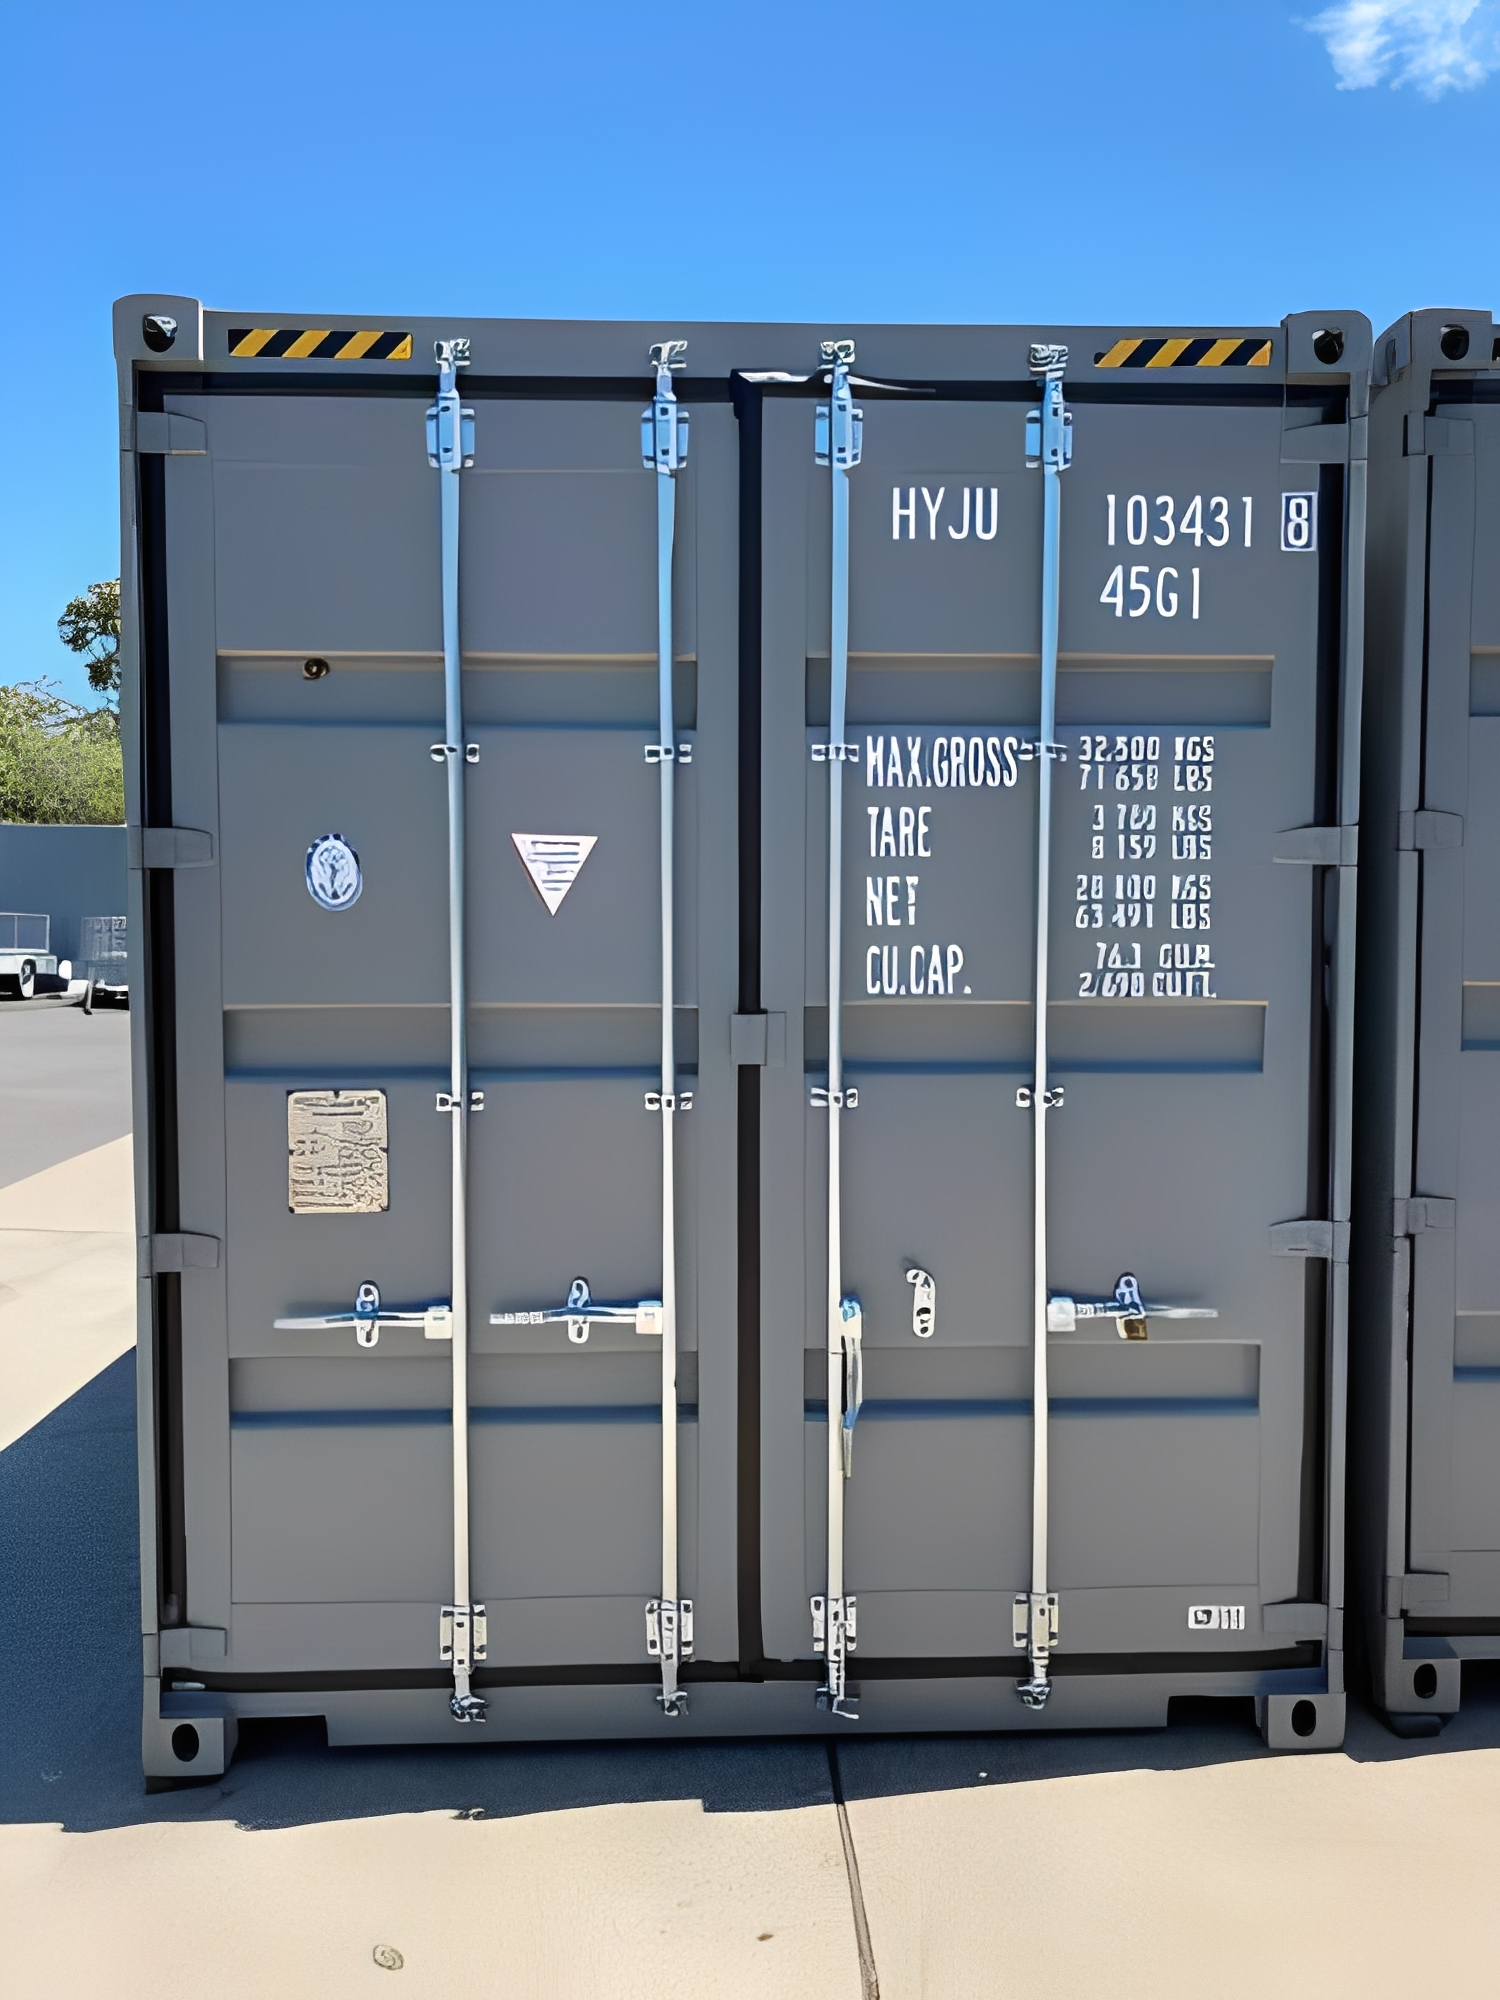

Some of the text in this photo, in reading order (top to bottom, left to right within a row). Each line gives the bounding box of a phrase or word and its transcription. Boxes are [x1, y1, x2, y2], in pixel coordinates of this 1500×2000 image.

[892, 486, 1311, 548] HYJU 103431 8
[1099, 564, 1200, 620] 45G1
[866, 735, 1018, 788] MAX.GROSS
[866, 805, 932, 858] TARE
[866, 875, 920, 927] NET
[866, 943, 972, 996] CU.CAP.
